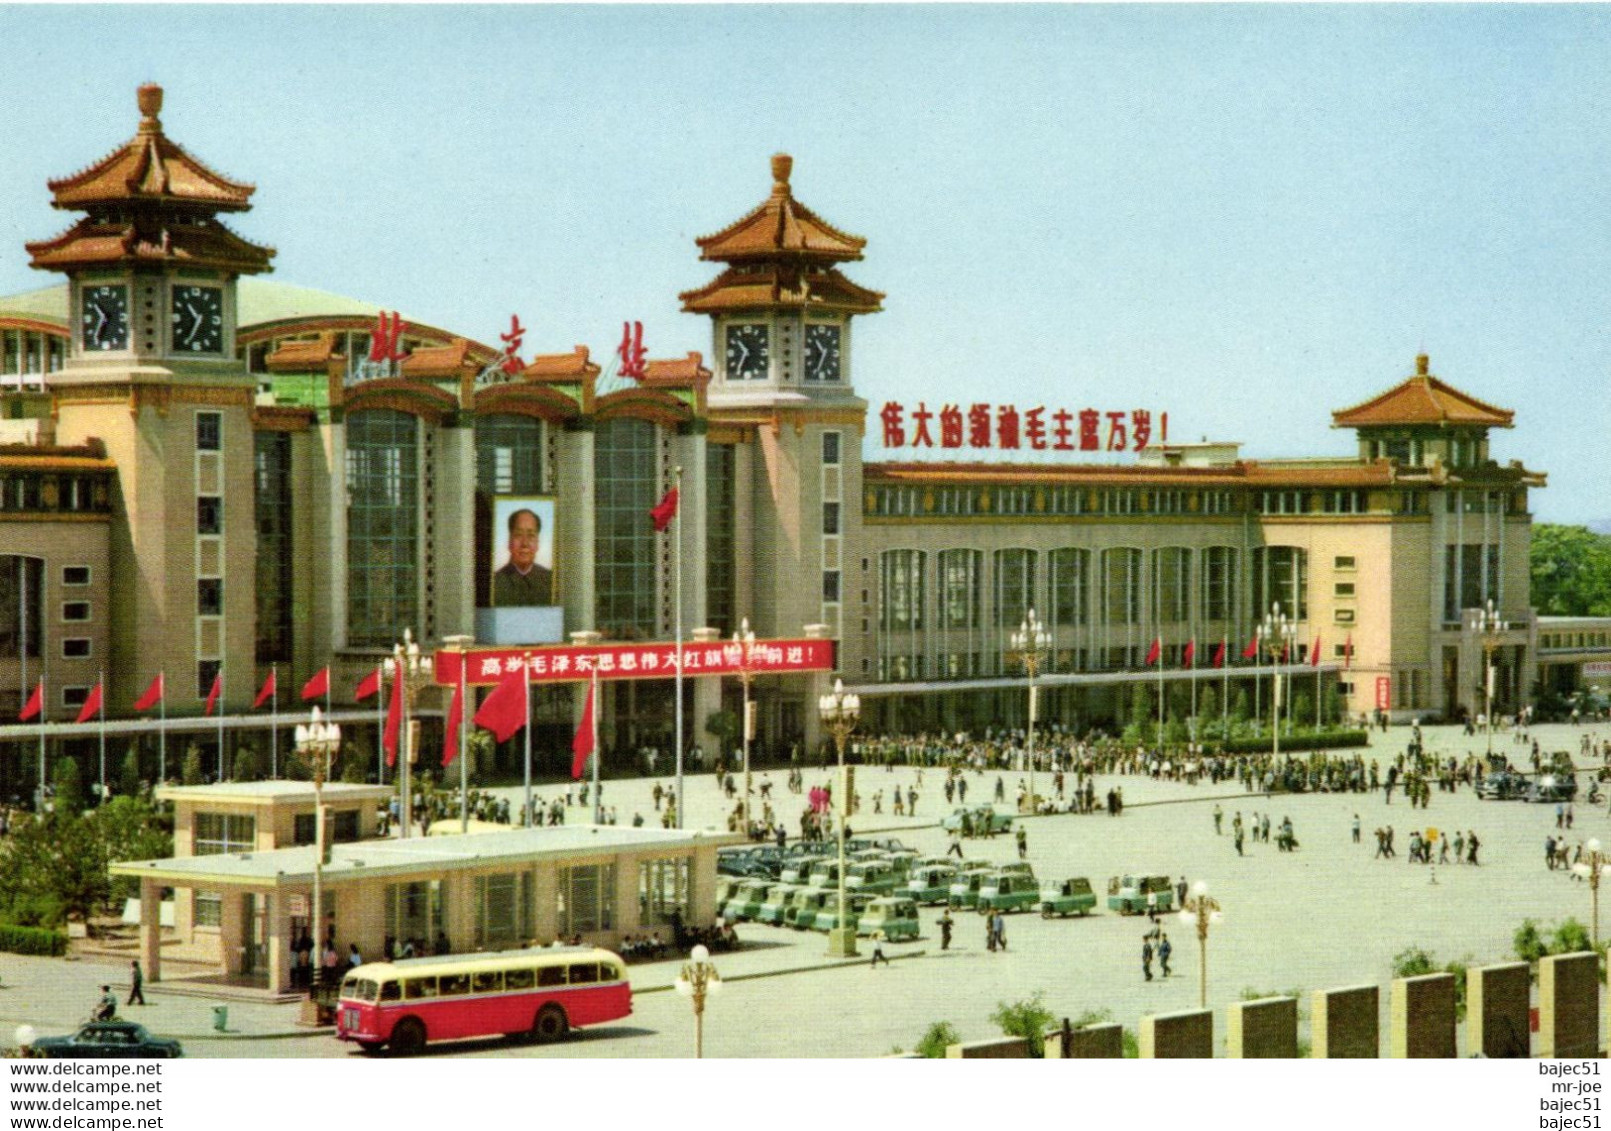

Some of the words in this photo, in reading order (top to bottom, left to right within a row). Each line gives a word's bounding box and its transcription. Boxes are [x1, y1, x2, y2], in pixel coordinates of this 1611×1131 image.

[879, 401, 1168, 452] 伟大的领袖毛主席万岁！
